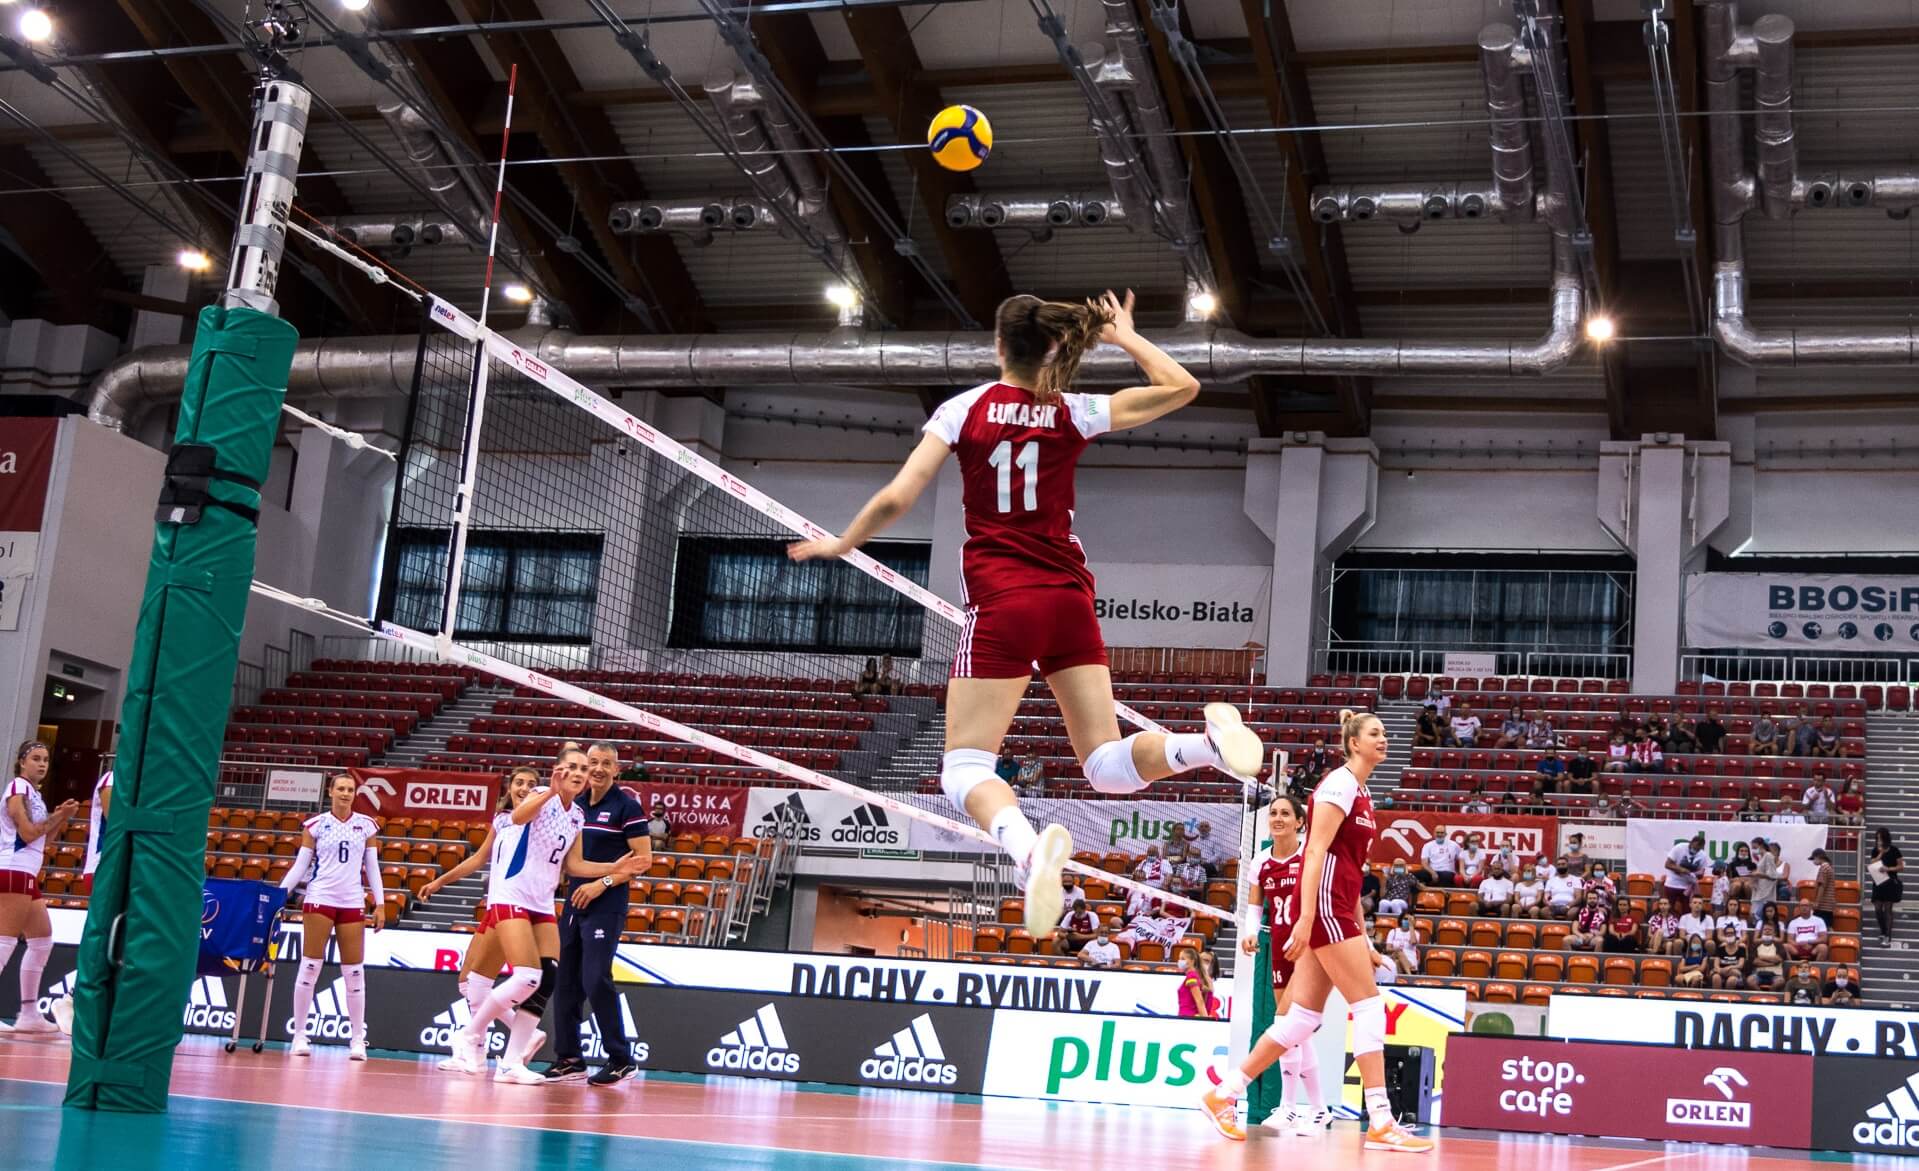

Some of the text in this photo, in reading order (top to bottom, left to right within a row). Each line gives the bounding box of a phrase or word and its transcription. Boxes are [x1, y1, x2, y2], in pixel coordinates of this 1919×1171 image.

[434, 304, 457, 322] netex
[988, 440, 1040, 513] 11
[1094, 598, 1254, 623] Bielsko-Biała
[1769, 585, 1919, 613] BBOSiR
[409, 786, 482, 807] ORLEN
[650, 792, 731, 810] POLSKA
[650, 809, 730, 826] SATKÓWKA
[1110, 811, 1174, 846] plus
[752, 822, 821, 841] addas
[832, 825, 898, 844] adidas
[338, 840, 349, 864] 6
[549, 835, 566, 864] 2
[1280, 877, 1296, 888] plu
[200, 927, 214, 940] V
[791, 963, 1101, 1011] DACHY RYNNY
[184, 1003, 236, 1030] idas
[286, 1013, 368, 1038] adida
[420, 1026, 505, 1052] ads
[1675, 1010, 1836, 1056] DACHY
[707, 1045, 799, 1074] adidas
[861, 1055, 957, 1085] adidas
[1046, 1020, 1197, 1094] plus
[1501, 1056, 1585, 1084] stop.
[1499, 1087, 1573, 1117] cafe
[1672, 1103, 1745, 1123] ORLEN
